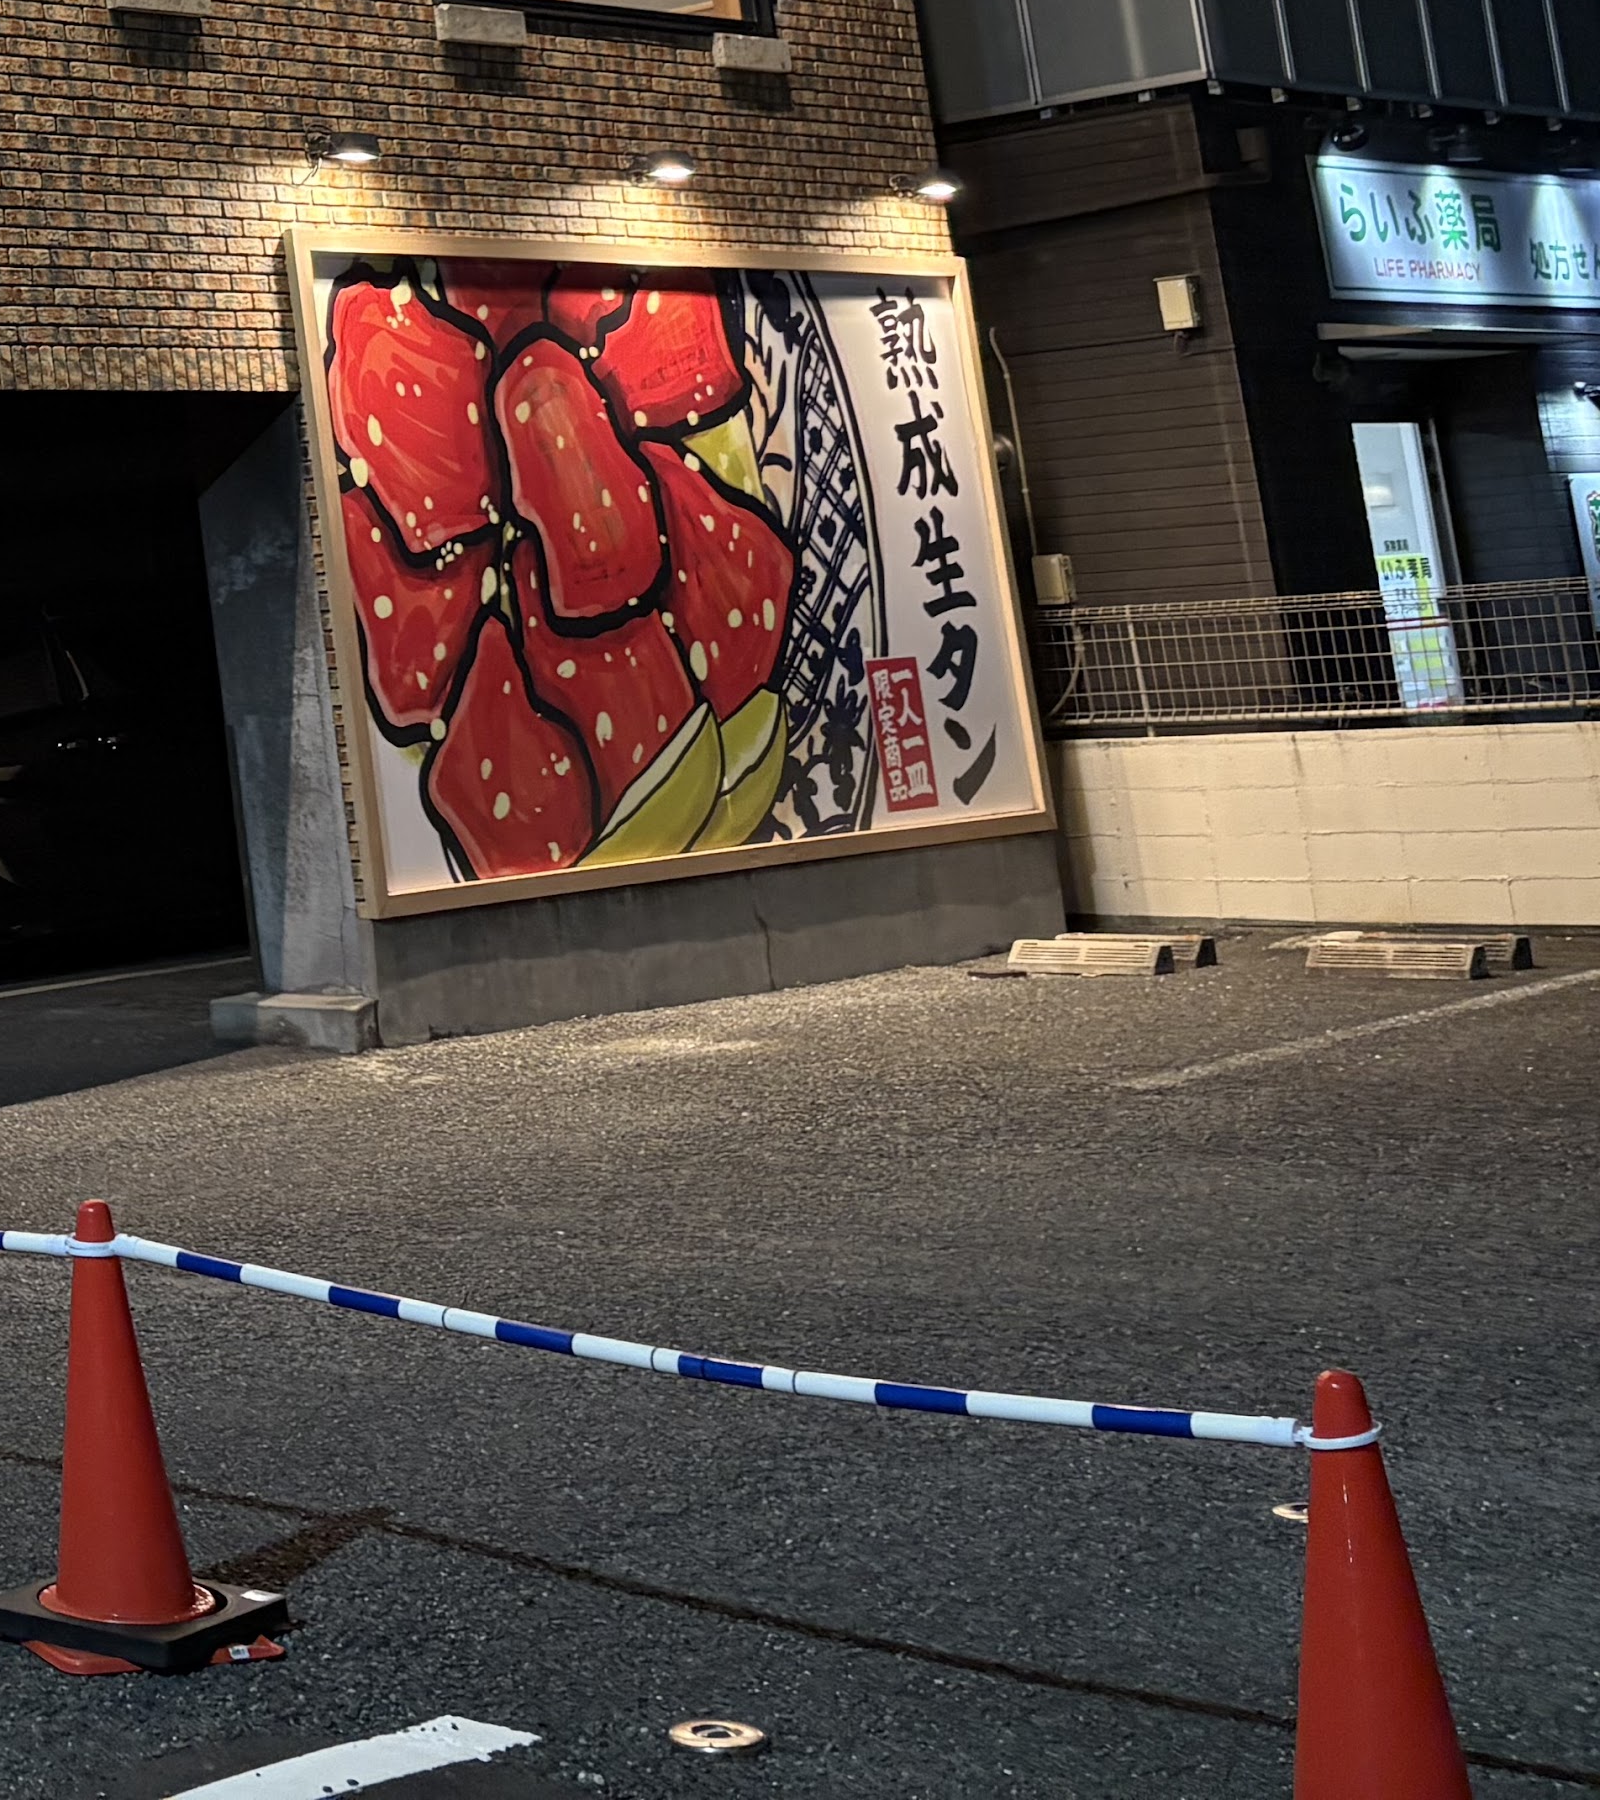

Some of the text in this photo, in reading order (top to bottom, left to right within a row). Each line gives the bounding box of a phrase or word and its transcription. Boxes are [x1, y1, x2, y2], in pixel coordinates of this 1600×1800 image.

[1339, 182, 1502, 253] らいふ薬局
[1373, 257, 1481, 281] LIFE PHARMACY
[869, 285, 997, 806] 熟成生タン
[871, 668, 909, 802] 限定商品
[890, 668, 934, 798] 一人一皿
